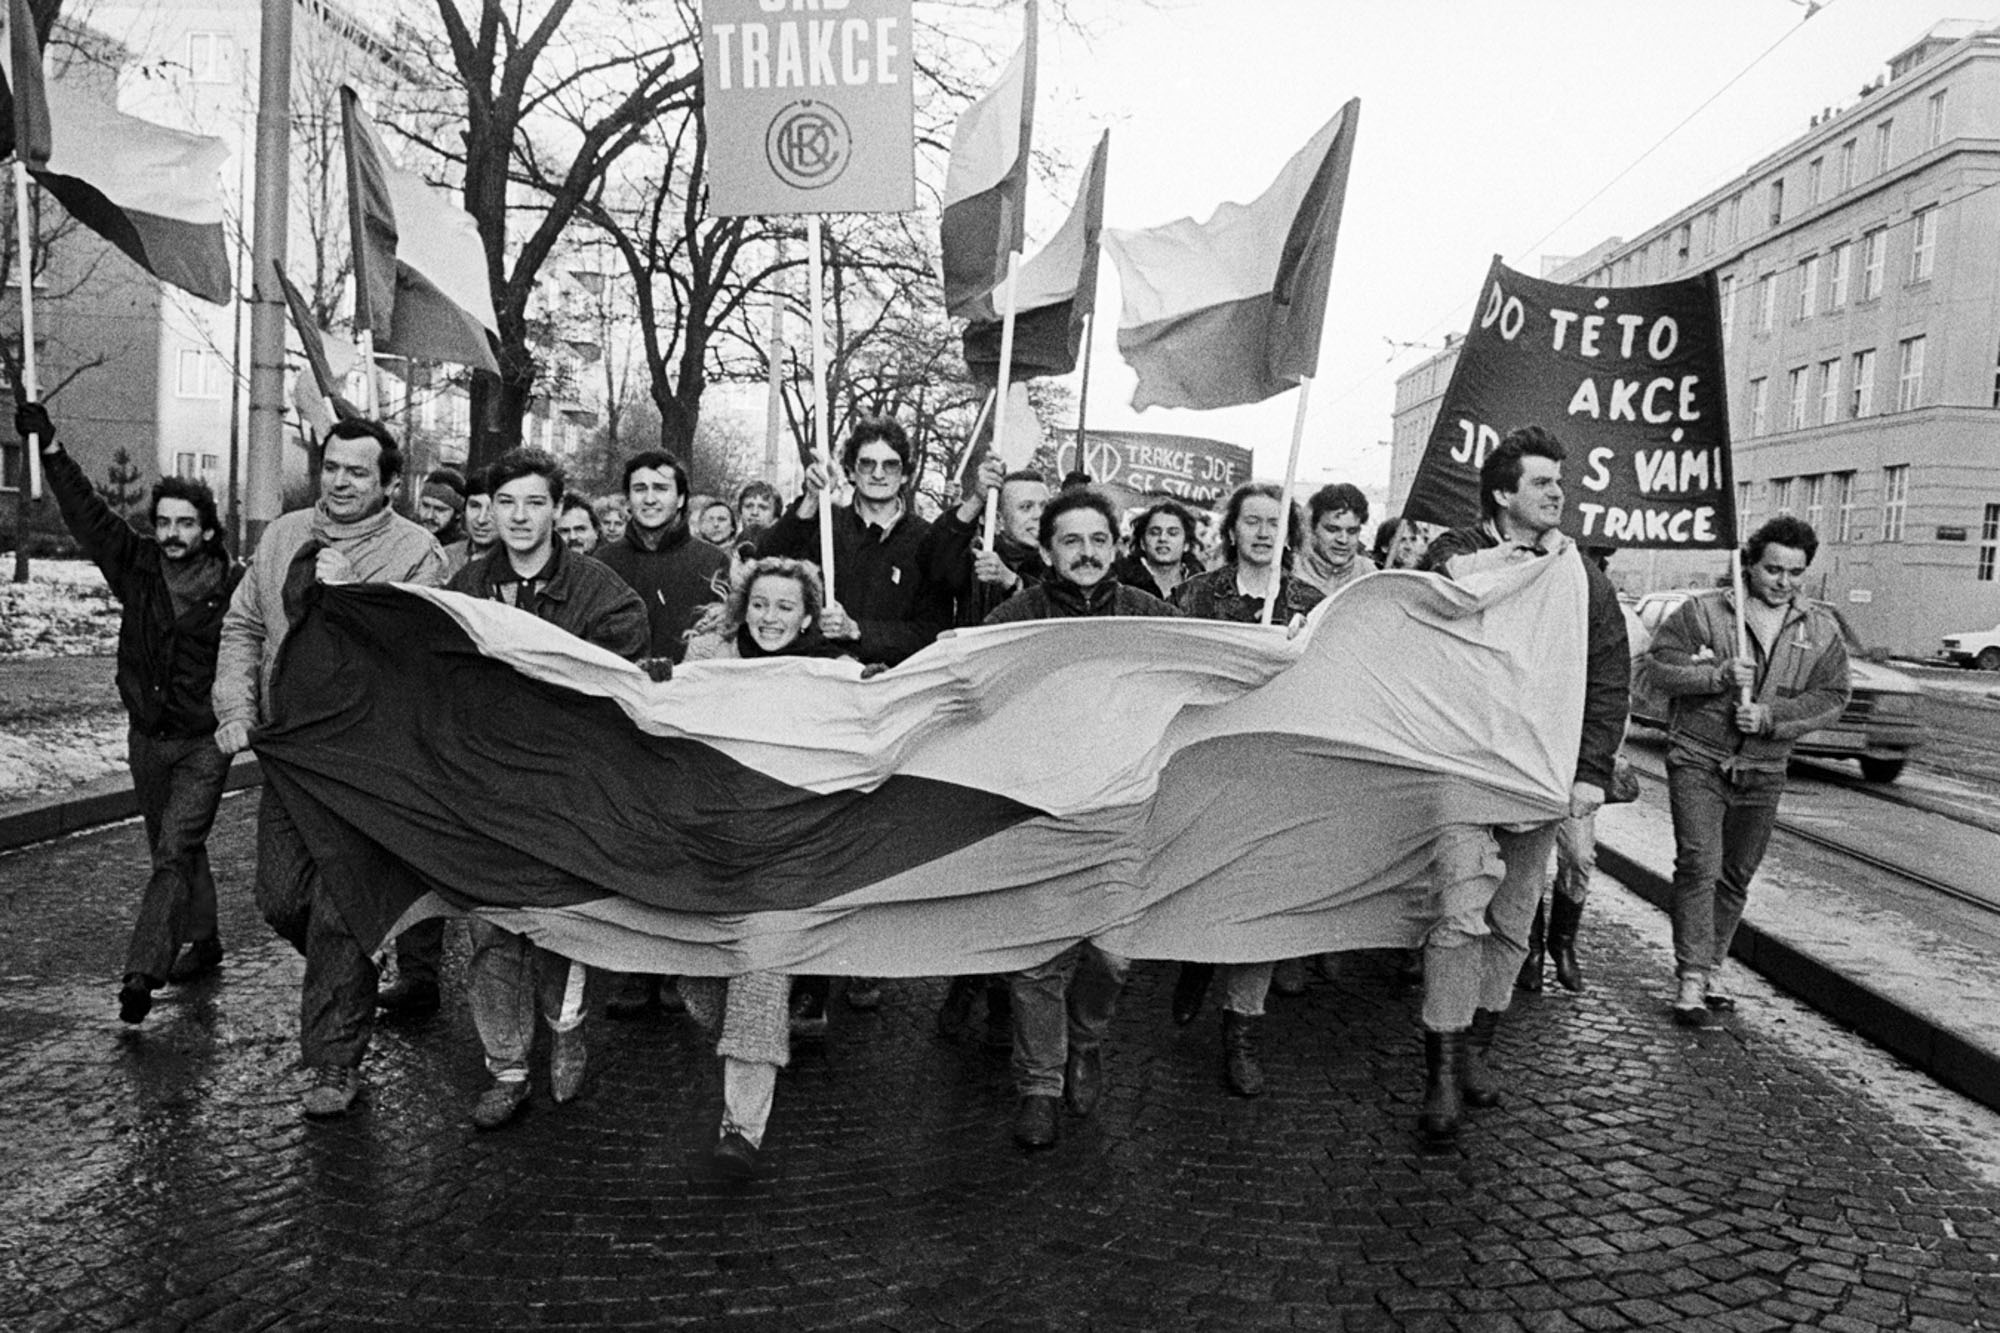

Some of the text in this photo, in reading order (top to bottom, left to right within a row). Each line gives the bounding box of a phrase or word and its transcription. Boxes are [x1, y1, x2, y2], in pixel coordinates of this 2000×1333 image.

[712, 17, 899, 90] TRAKCE
[1480, 280, 1679, 361] DO TÉTO
[1567, 375, 1701, 424] AKCE
[1125, 444, 1235, 486] TRAKCE JDE
[1450, 418, 1722, 493] JD S VÁMI
[1127, 473, 1230, 501] SE STUDE
[1578, 502, 1717, 543] TRAKCE
